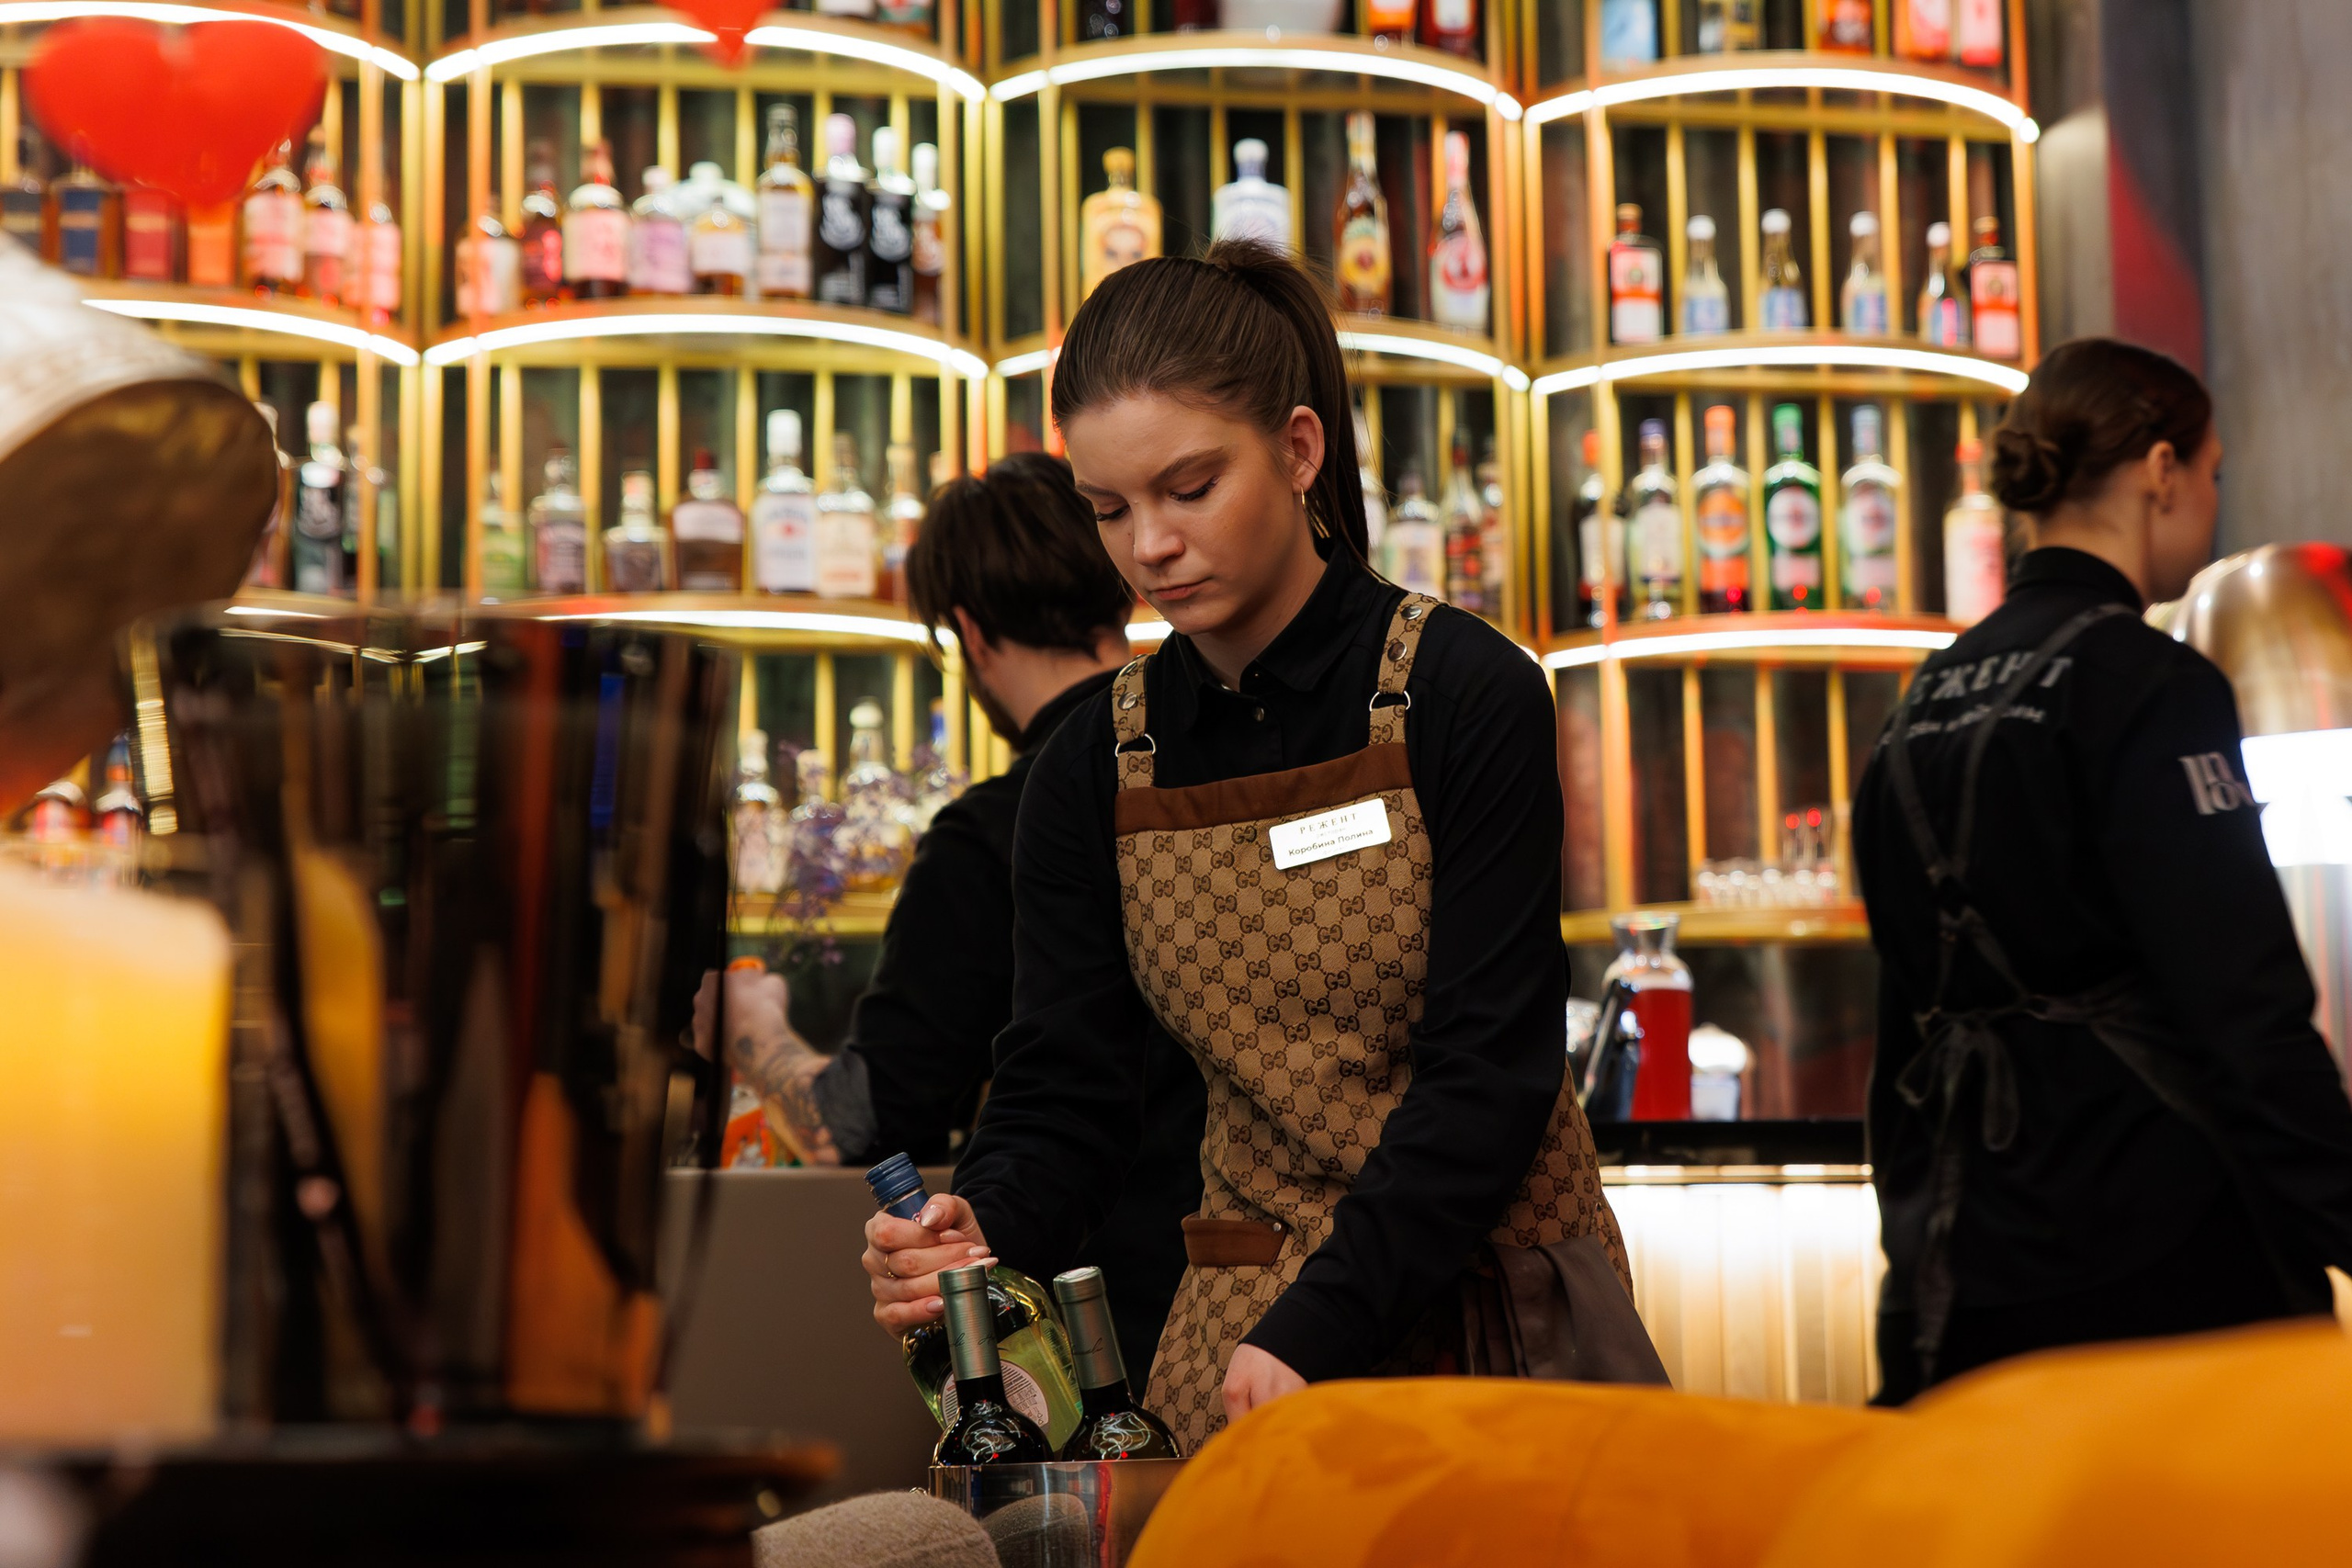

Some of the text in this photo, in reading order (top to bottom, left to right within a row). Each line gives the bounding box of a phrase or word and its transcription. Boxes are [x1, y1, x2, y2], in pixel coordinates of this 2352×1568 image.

[1300, 813, 1357, 834] РЕЖЕНТ
[1288, 840, 1336, 856] Коробина
[1338, 829, 1374, 843] Полина
